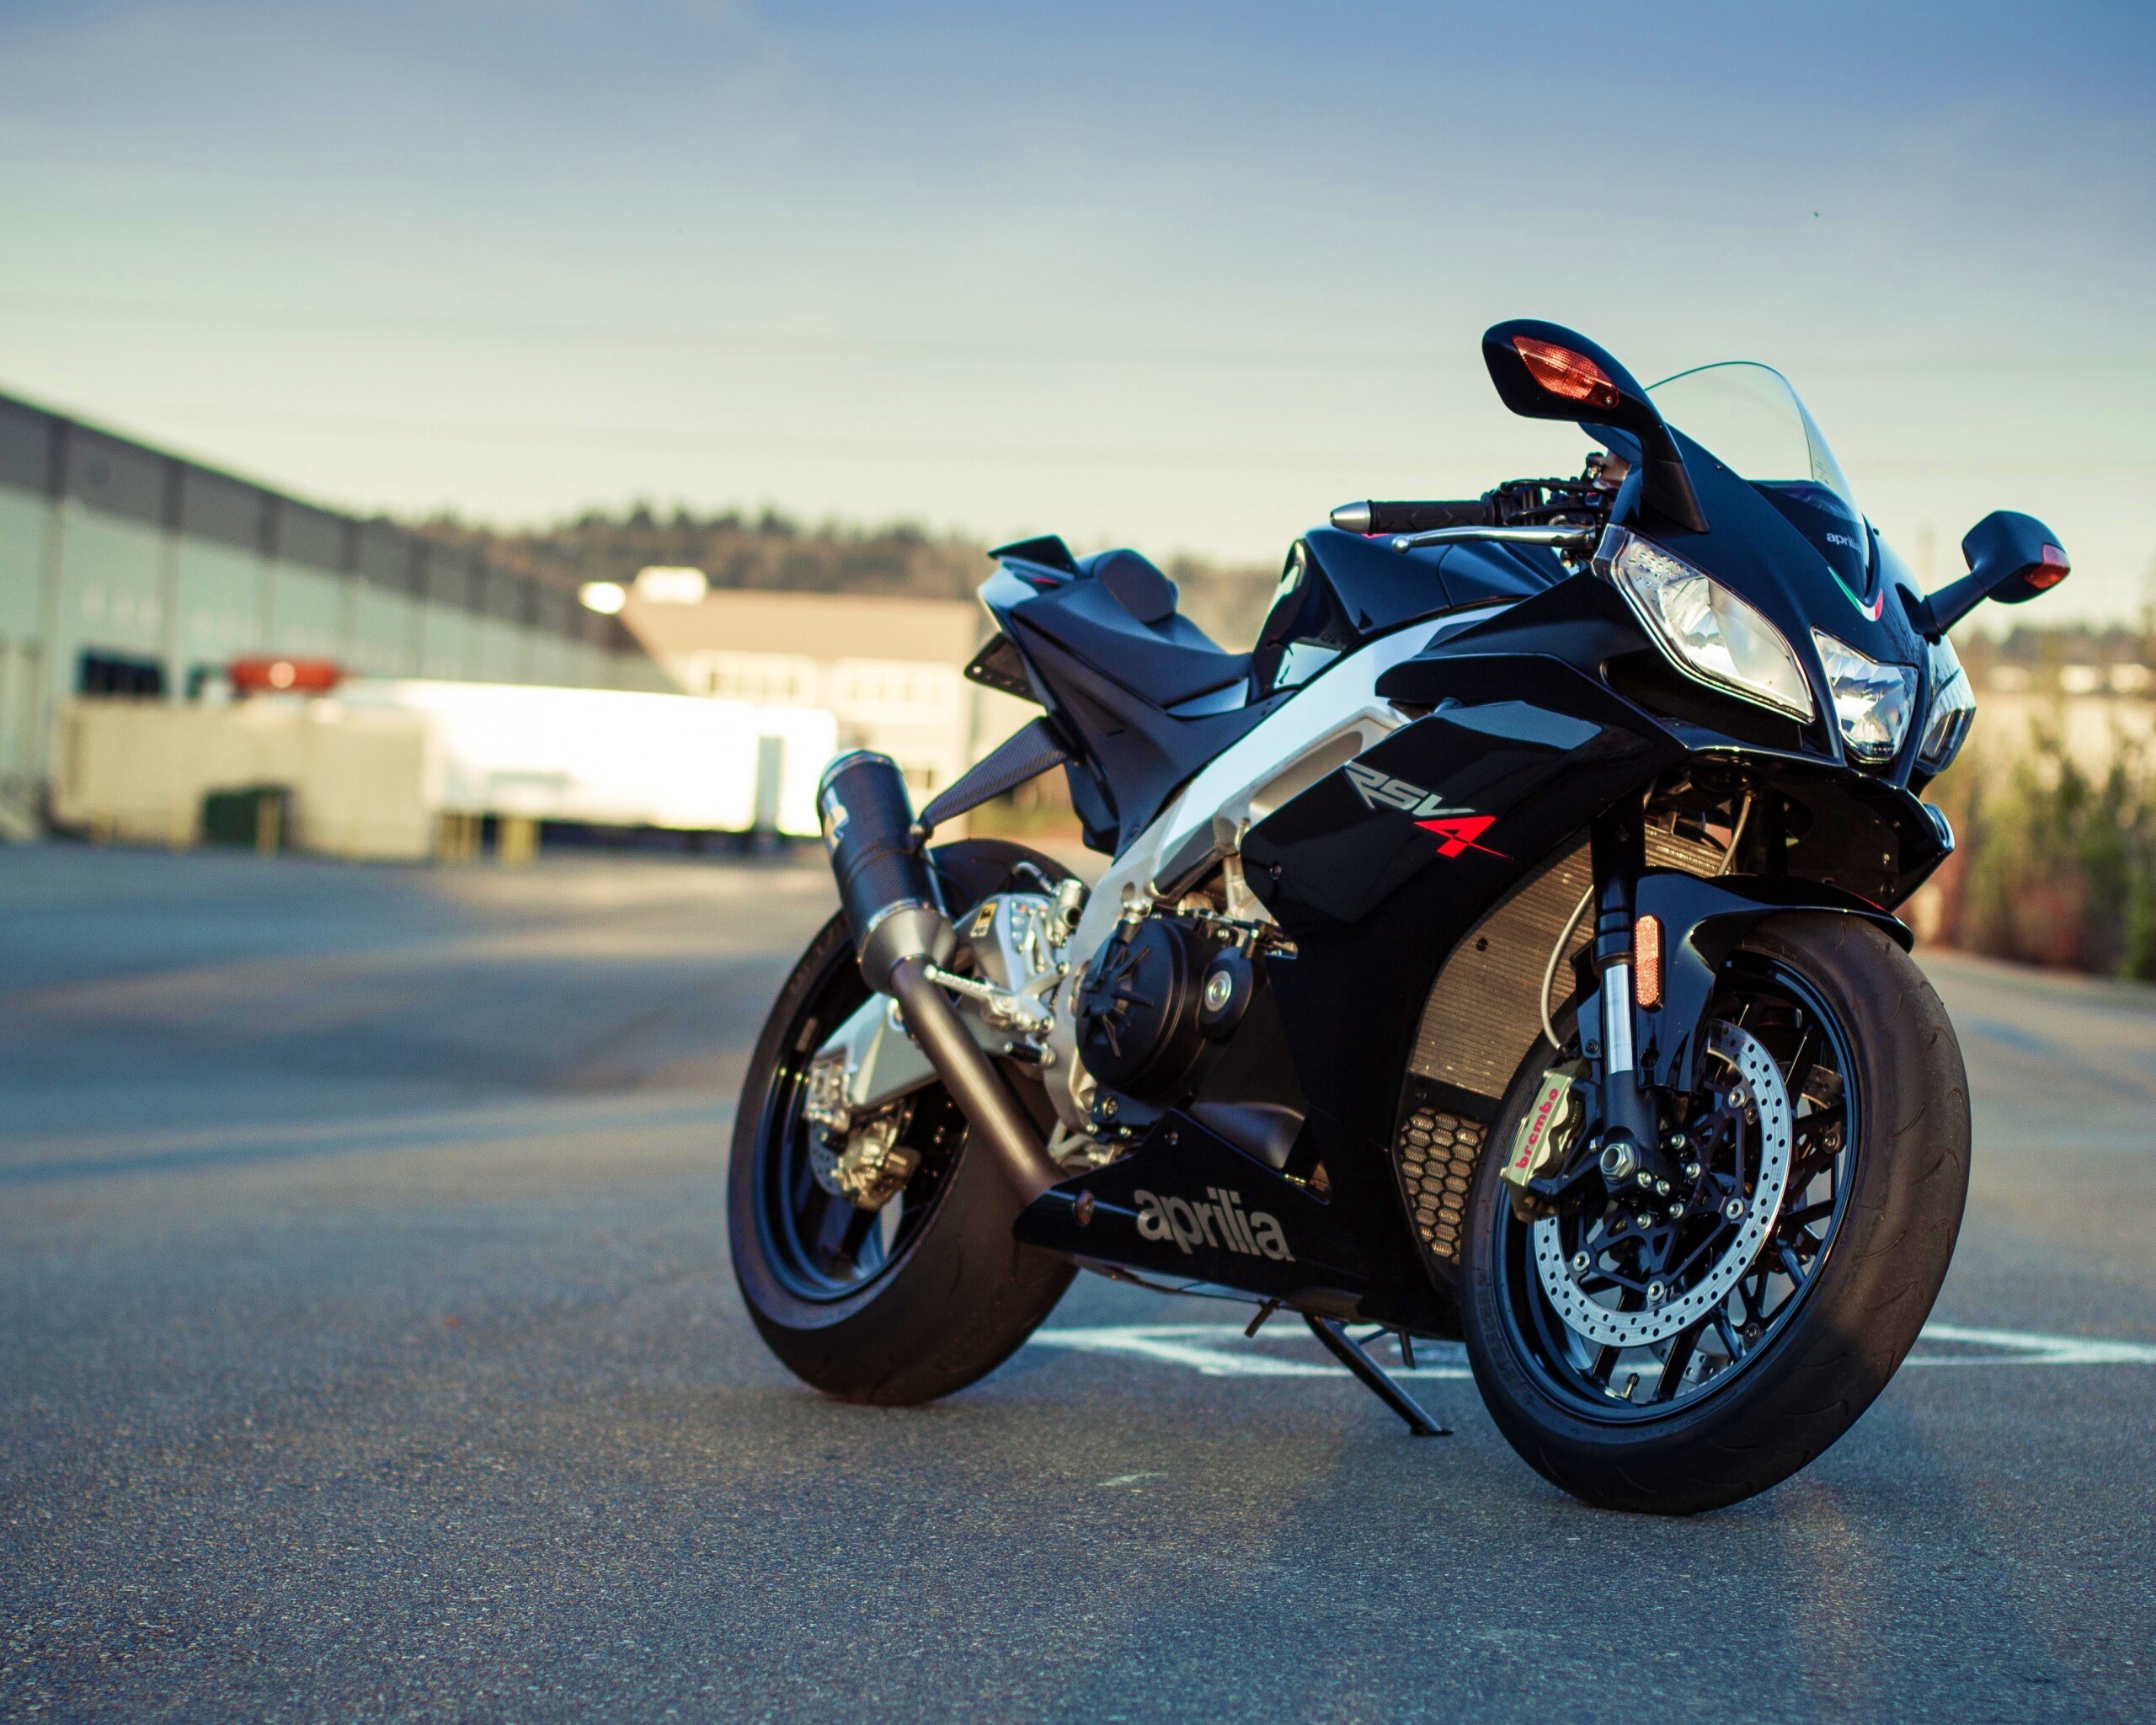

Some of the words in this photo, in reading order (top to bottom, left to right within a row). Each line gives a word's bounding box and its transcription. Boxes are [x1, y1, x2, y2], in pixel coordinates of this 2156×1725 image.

[1826, 532, 1862, 553] aprilia
[1515, 1088, 1558, 1168] brembo
[1134, 1187, 1296, 1262] aprilia
